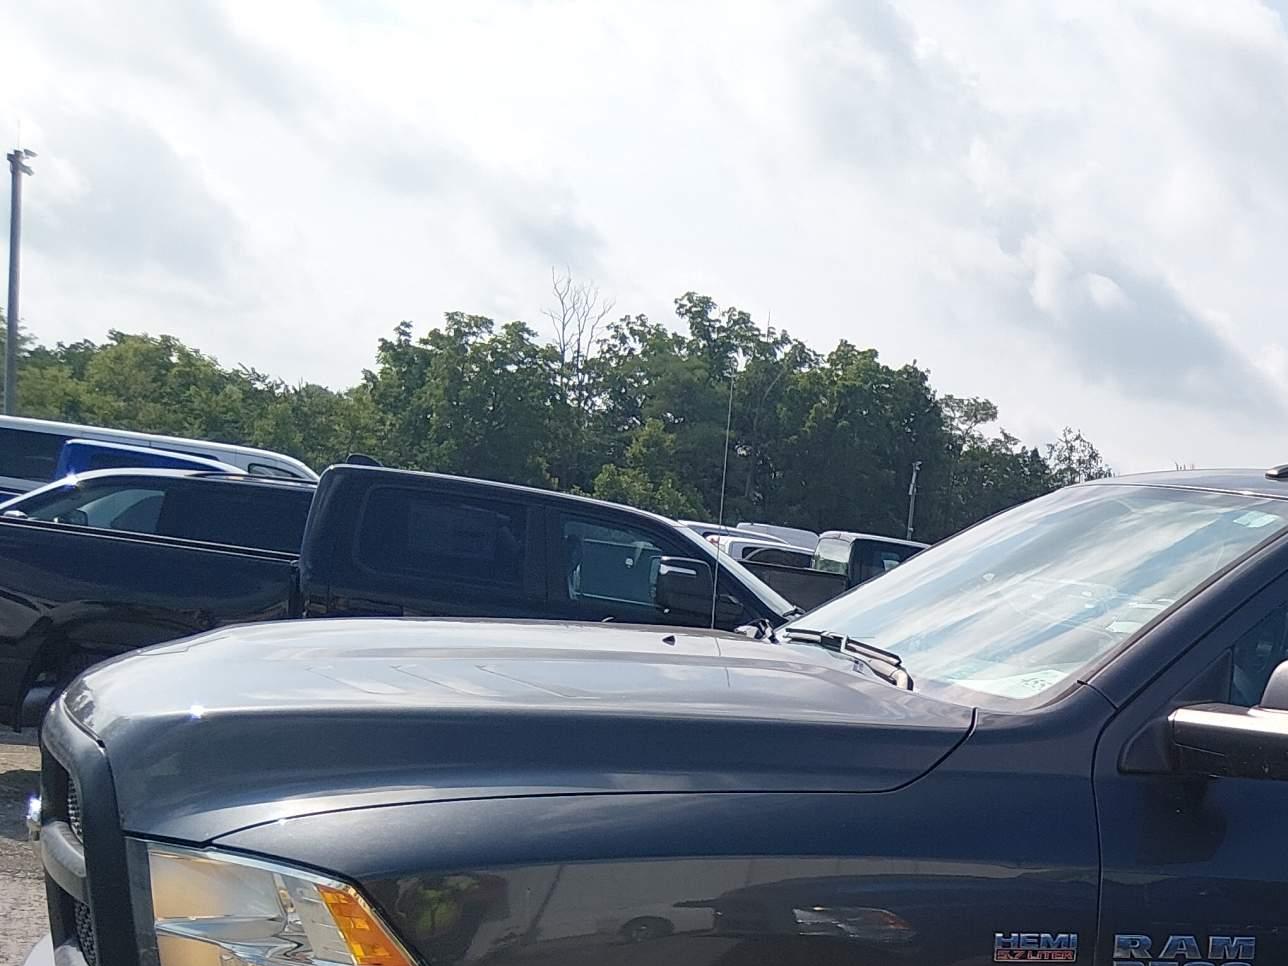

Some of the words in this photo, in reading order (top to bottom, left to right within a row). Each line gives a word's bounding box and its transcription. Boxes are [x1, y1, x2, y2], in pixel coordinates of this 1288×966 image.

[994, 932, 1078, 949] HEMI
[1112, 934, 1256, 960] RAM
[1027, 950, 1073, 960] LITER
